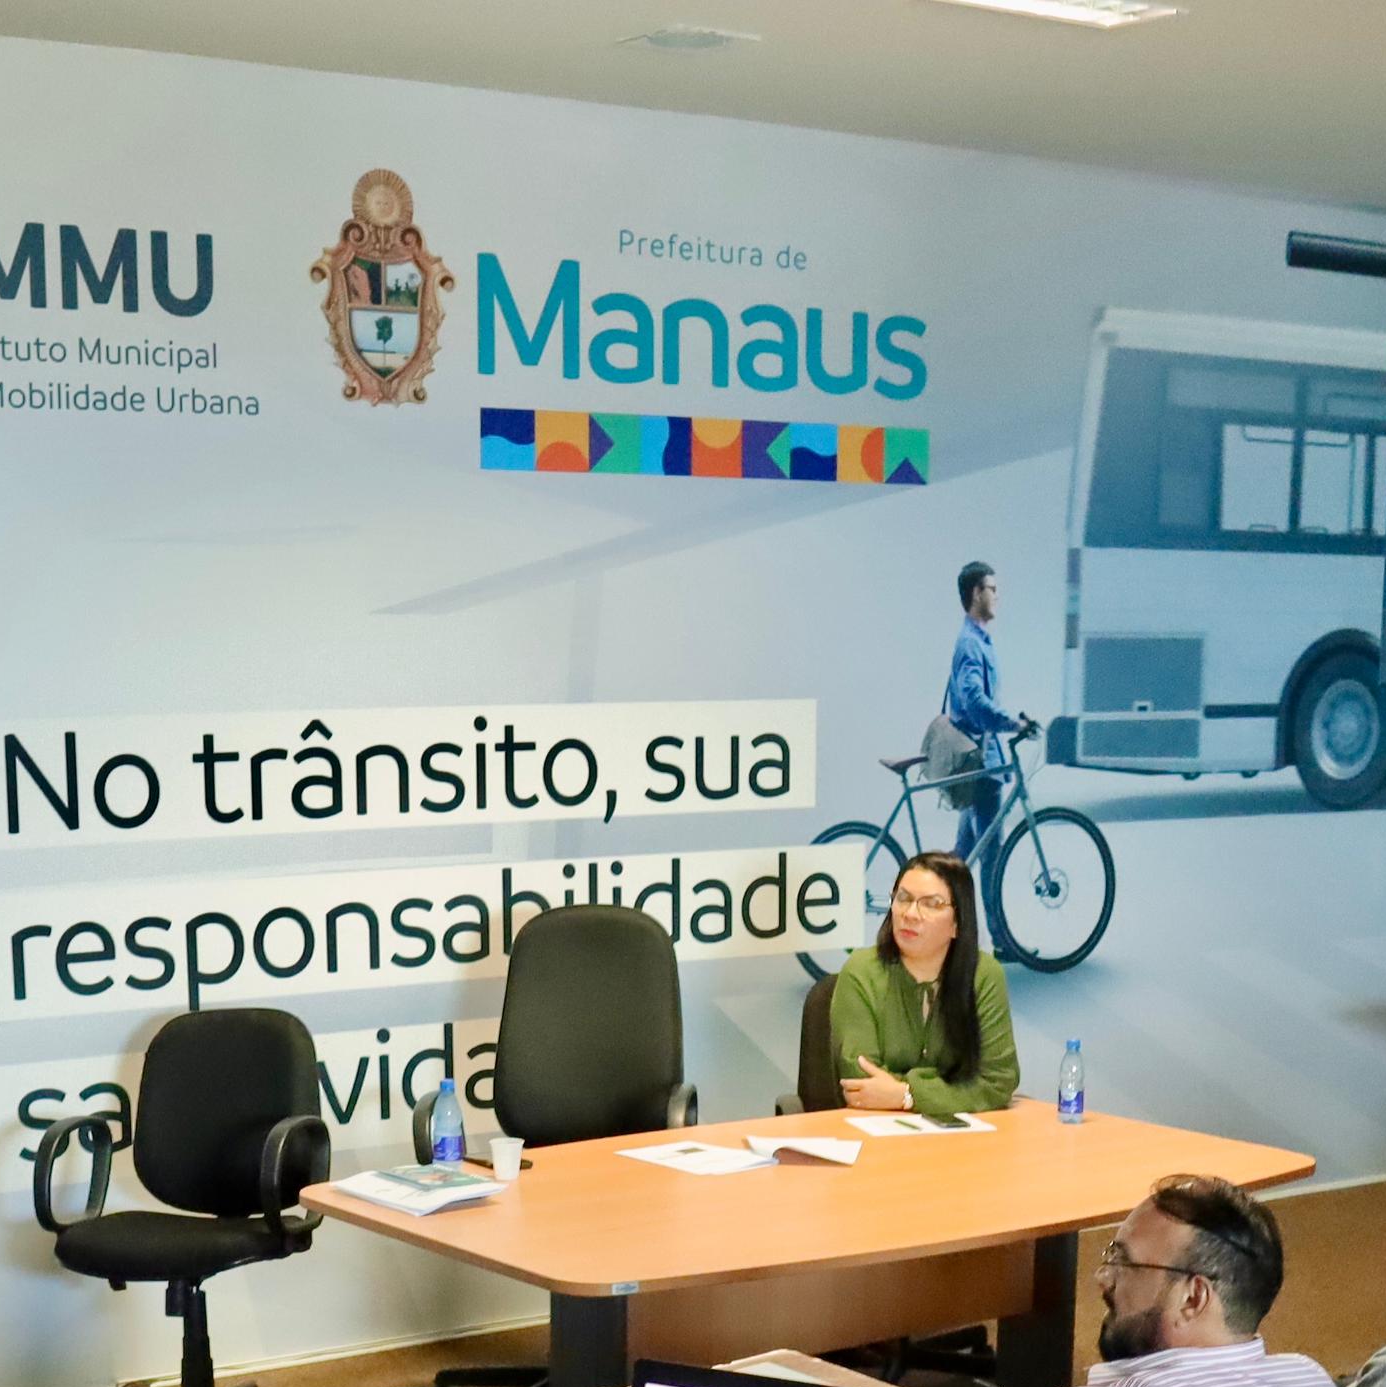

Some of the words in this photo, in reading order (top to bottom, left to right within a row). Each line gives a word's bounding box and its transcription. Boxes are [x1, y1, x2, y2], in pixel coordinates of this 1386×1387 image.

[618, 229, 763, 267] Prefeitura
[776, 245, 808, 271] de
[476, 251, 928, 401] Manaus
[78, 336, 218, 374] Municipal
[156, 386, 261, 416] Urbana
[3, 730, 161, 835] No
[192, 716, 617, 825] trânsito,
[644, 732, 791, 802] sua
